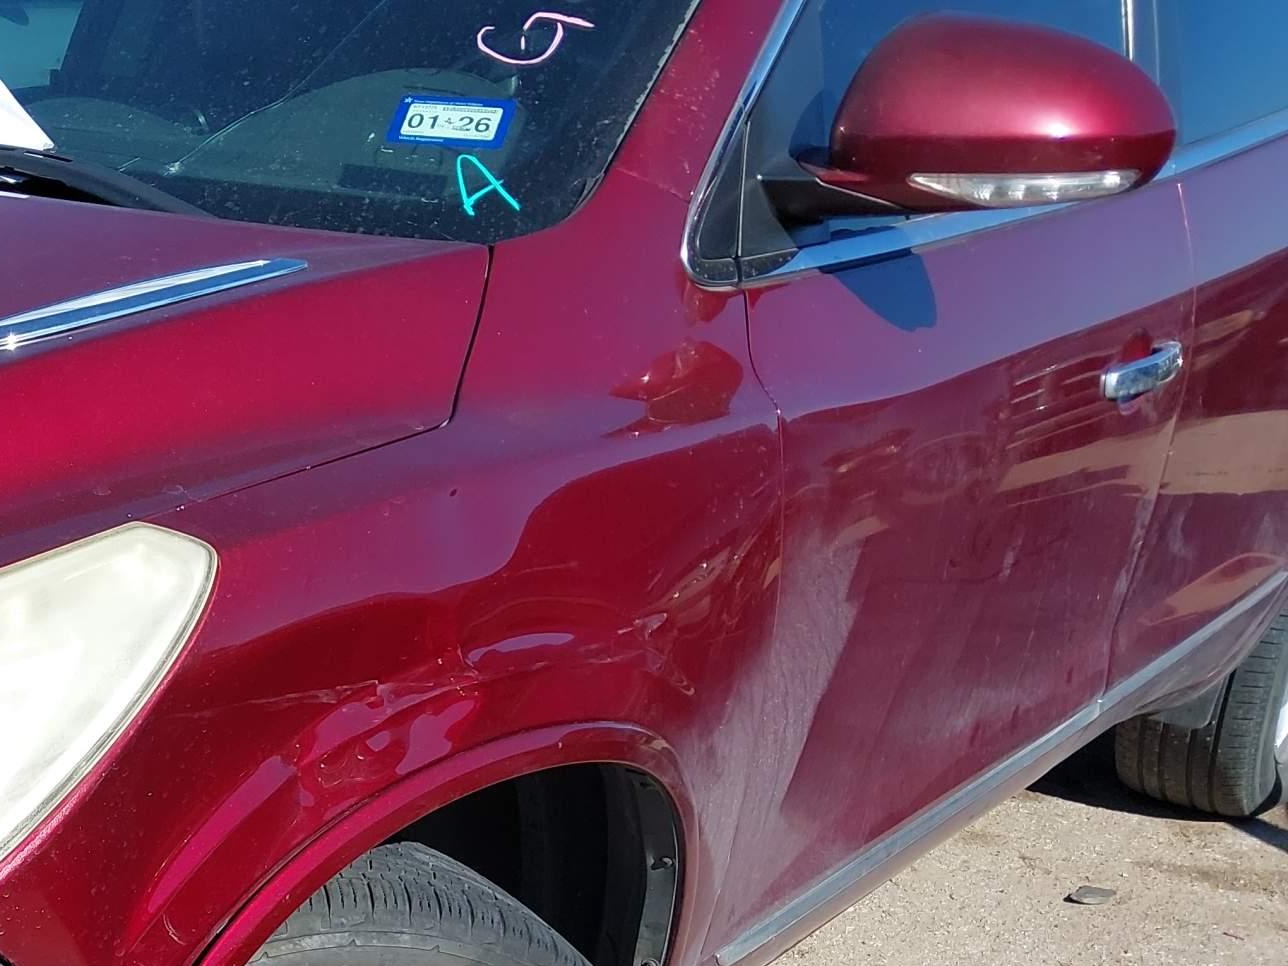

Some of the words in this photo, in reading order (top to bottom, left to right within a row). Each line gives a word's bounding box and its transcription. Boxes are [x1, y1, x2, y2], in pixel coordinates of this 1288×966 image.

[407, 113, 439, 130] 01
[458, 115, 492, 133] 26
[456, 154, 520, 216] A
